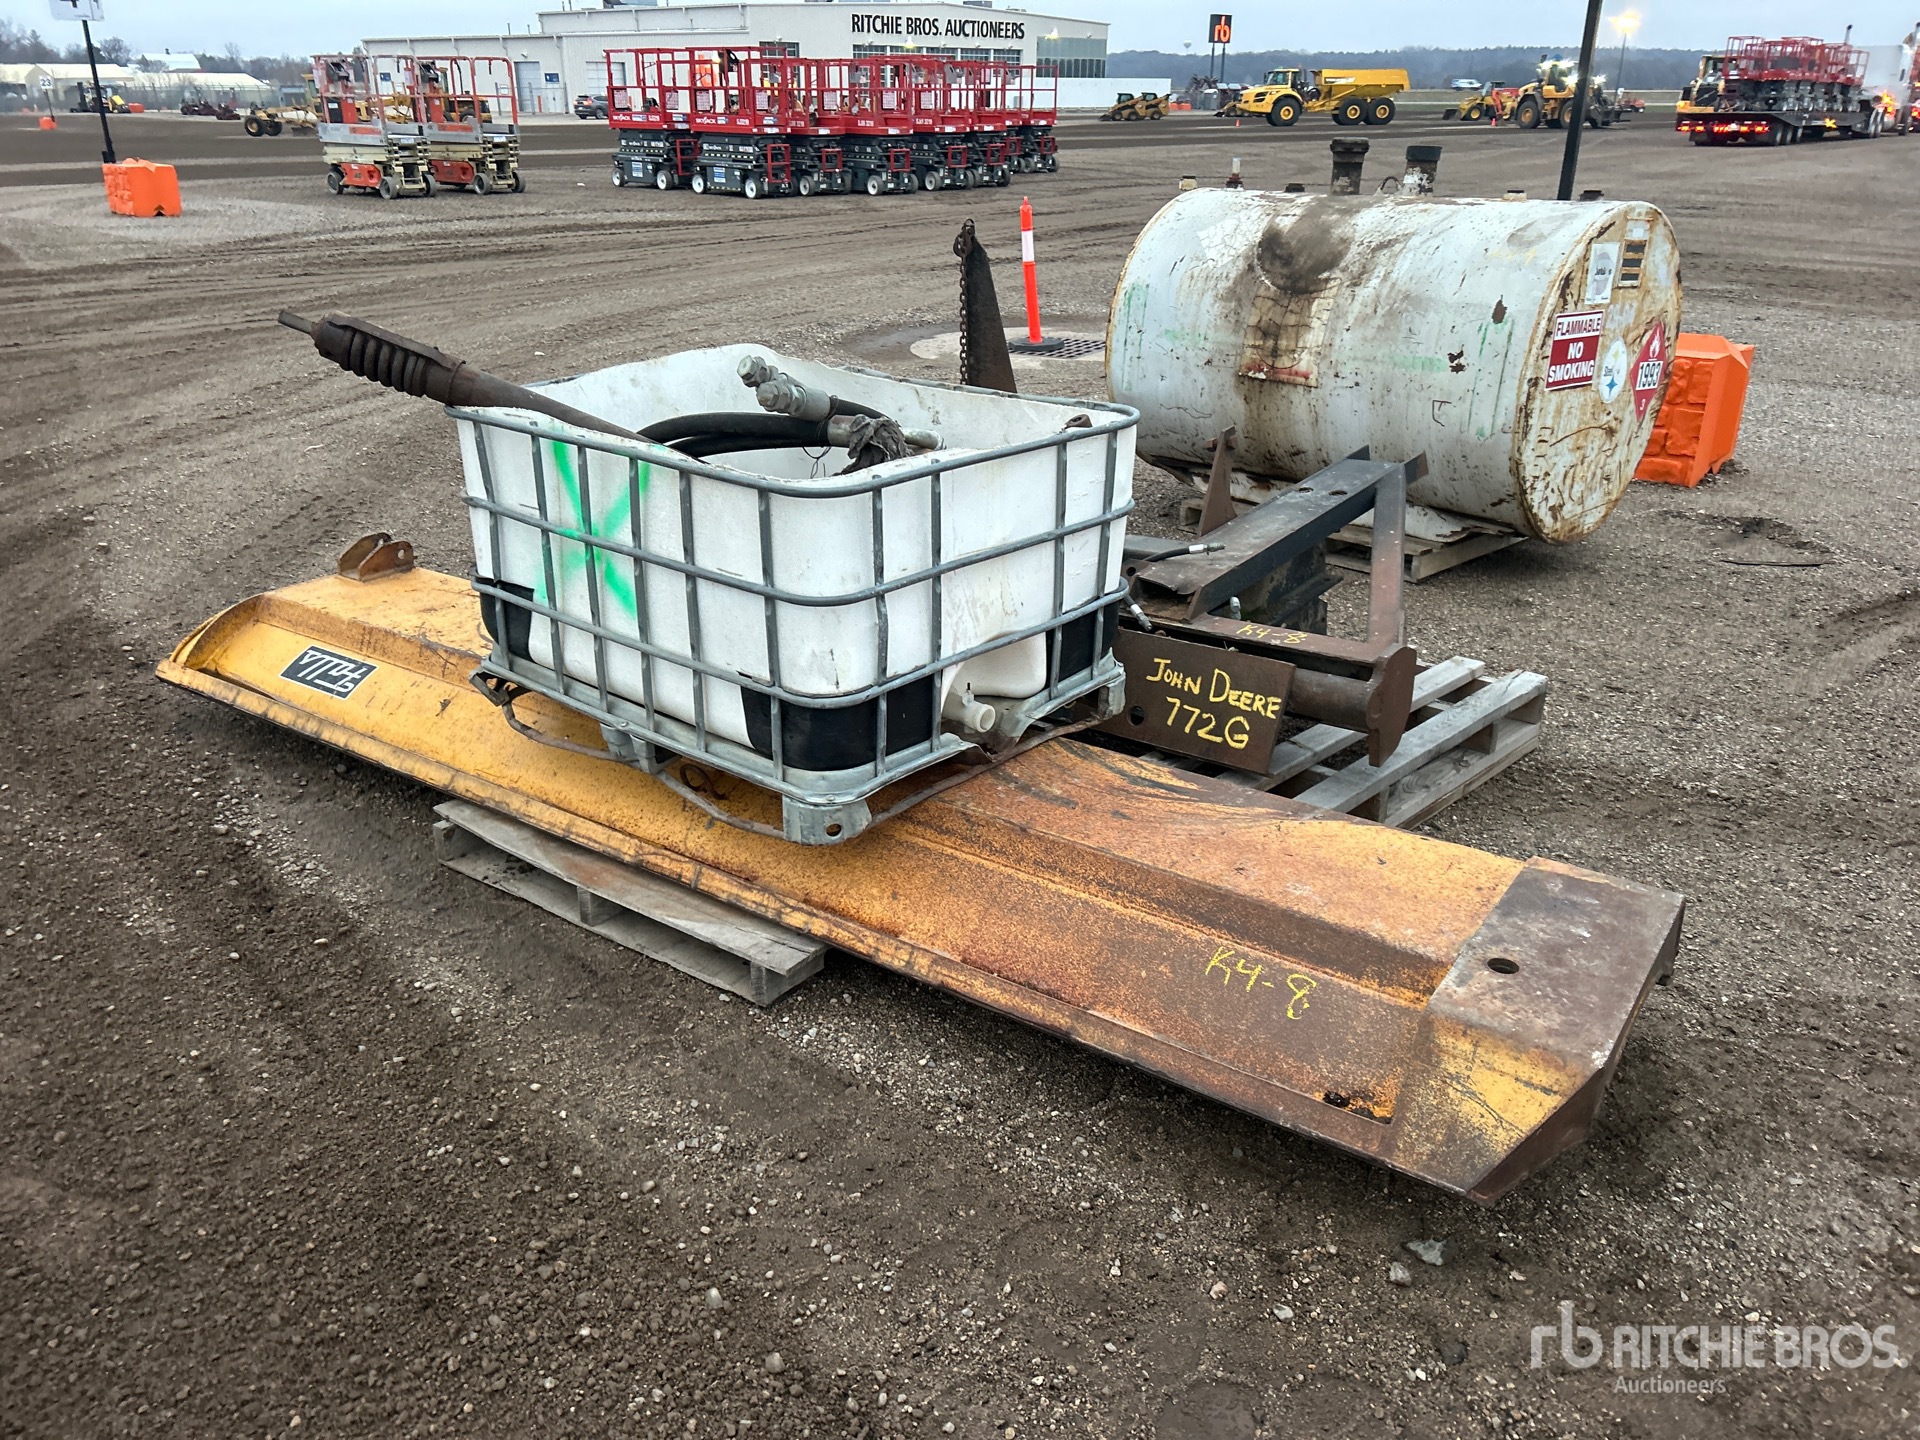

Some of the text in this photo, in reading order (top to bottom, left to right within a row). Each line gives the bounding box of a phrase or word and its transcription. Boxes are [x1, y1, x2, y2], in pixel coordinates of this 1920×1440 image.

[851, 14, 1025, 40] RITCHIE BROS. AUCTIONEERS
[1214, 15, 1230, 42] rb
[40, 78, 52, 87] 23
[1555, 318, 1601, 337] FLAMMABLE
[1567, 341, 1584, 360] NO
[1548, 360, 1595, 383] SMOKING
[1637, 362, 1661, 389] 1993
[1639, 398, 1646, 411] 3
[1236, 623, 1308, 644] K4-8
[1146, 657, 1202, 695] JOHN
[1209, 668, 1282, 720] DEERE
[1166, 696, 1250, 750] 772G
[1205, 945, 1317, 1020] K4-8
